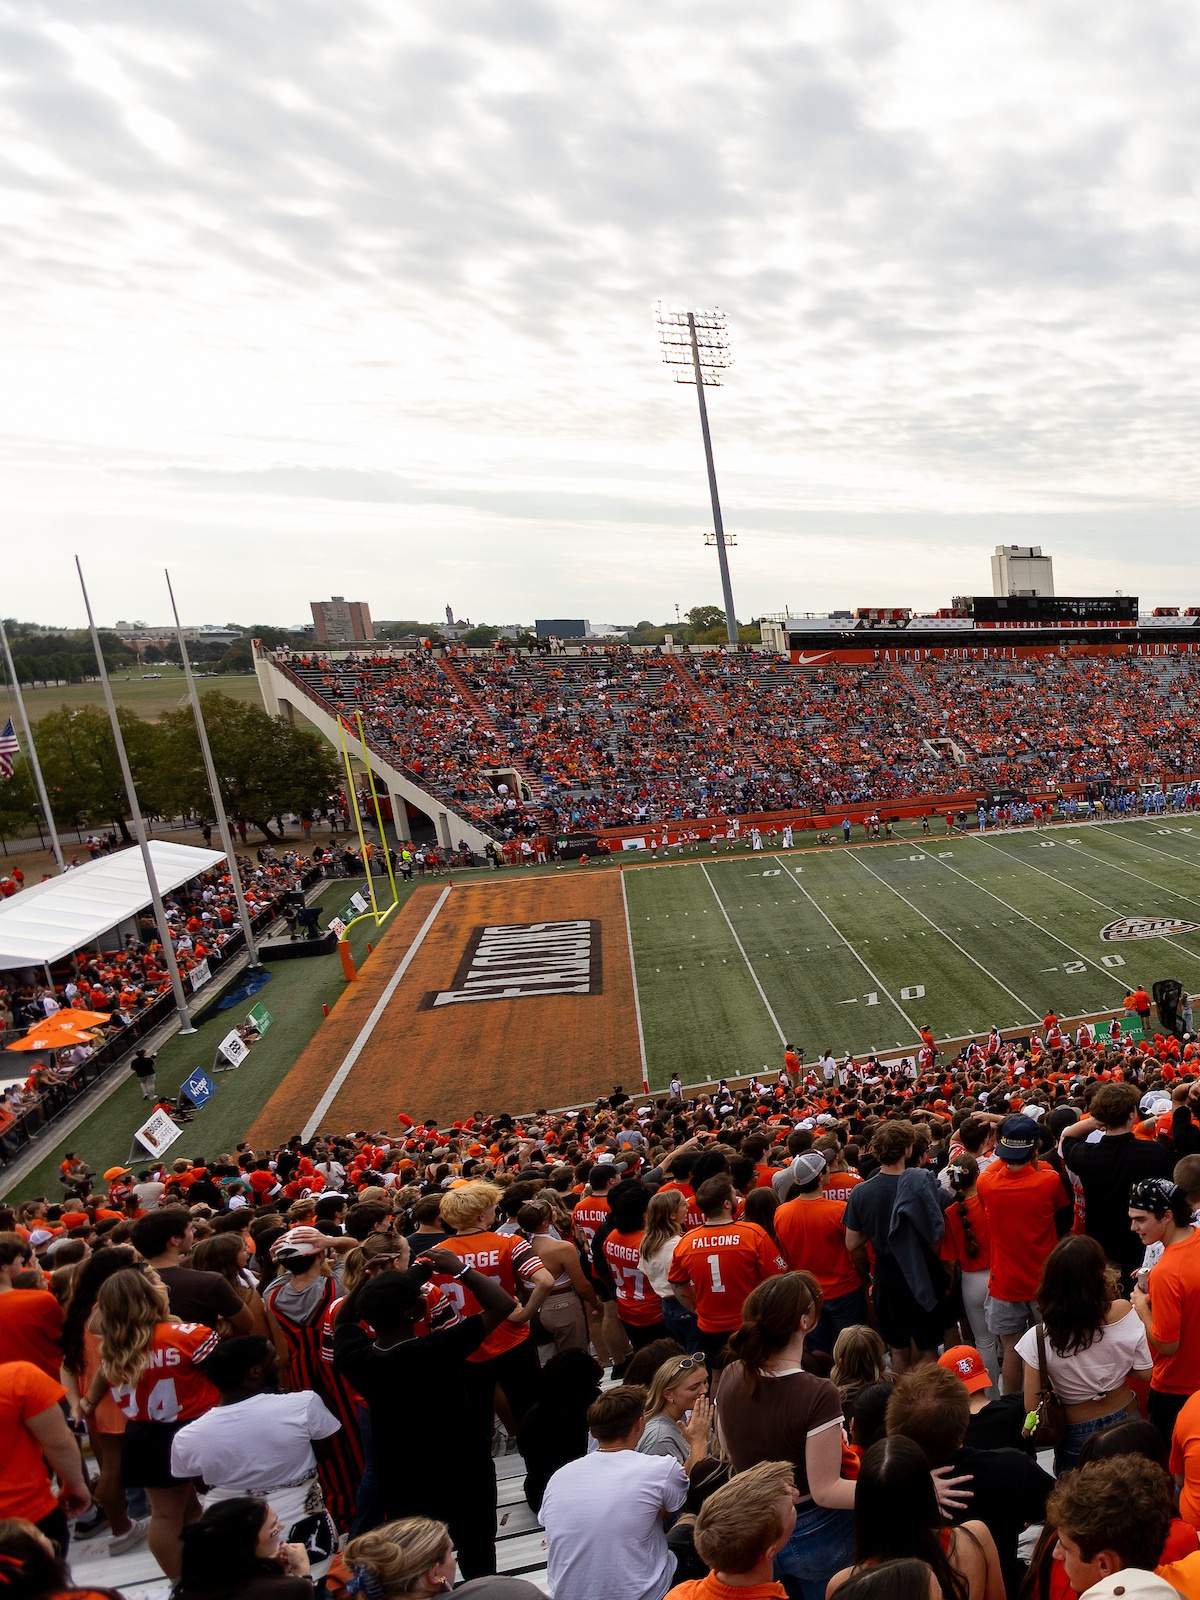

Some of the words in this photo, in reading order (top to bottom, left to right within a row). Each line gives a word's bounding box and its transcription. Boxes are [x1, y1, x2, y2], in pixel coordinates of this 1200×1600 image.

[874, 649, 932, 662] FALCON
[944, 648, 1018, 660] FOOTBALL
[1127, 643, 1179, 655] TALONS
[909, 851, 954, 861] 20
[433, 920, 592, 1006] FALCONS
[1062, 954, 1126, 975] 20
[863, 985, 926, 1007] 10
[189, 1077, 210, 1097] Kroger
[576, 1210, 607, 1223] FALCON
[605, 1240, 640, 1263] GEORGE
[692, 1234, 741, 1250] FALCONS
[707, 1254, 726, 1293] 1
